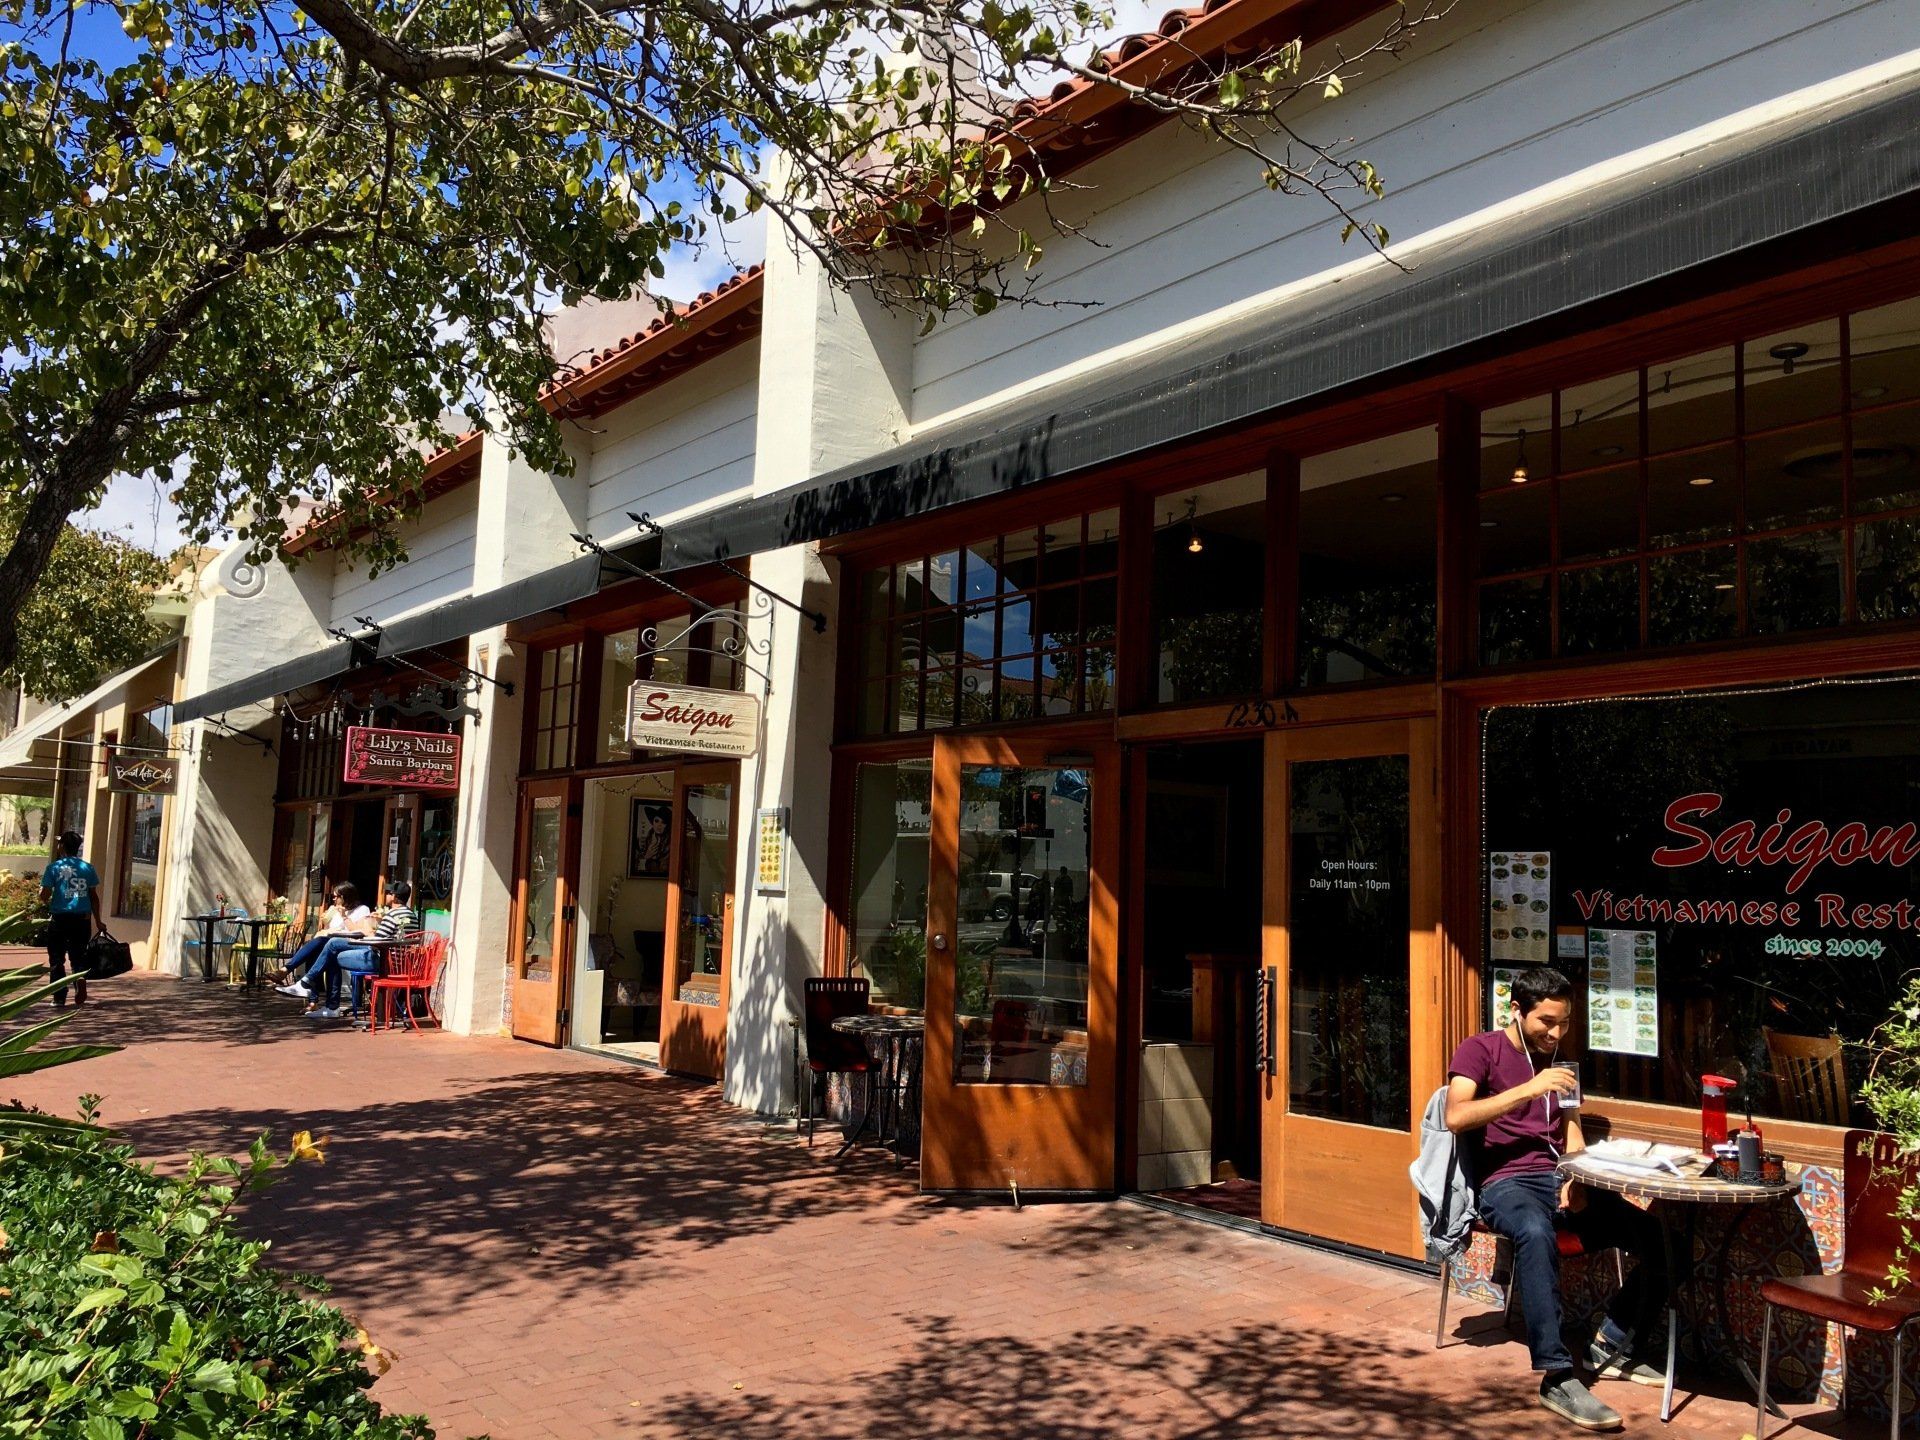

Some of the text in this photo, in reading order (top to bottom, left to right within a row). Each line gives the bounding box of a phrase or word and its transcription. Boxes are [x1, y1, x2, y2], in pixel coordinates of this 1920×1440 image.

[640, 692, 735, 736] Saigon
[369, 733, 453, 754] Lily's Nails
[643, 735, 746, 751] Vietnamese Restaurant
[369, 754, 453, 771] Santa Barbara
[138, 765, 153, 782] Arts
[1652, 792, 1920, 894] Saigon
[1321, 859, 1378, 873] Open Hours:
[69, 877, 88, 892] SB
[1309, 878, 1332, 891] Daily
[1333, 878, 1357, 889] 11am
[1365, 879, 1391, 892] 10pm
[1572, 889, 1800, 926] Vietnamese
[1764, 933, 1886, 960] since 2004
